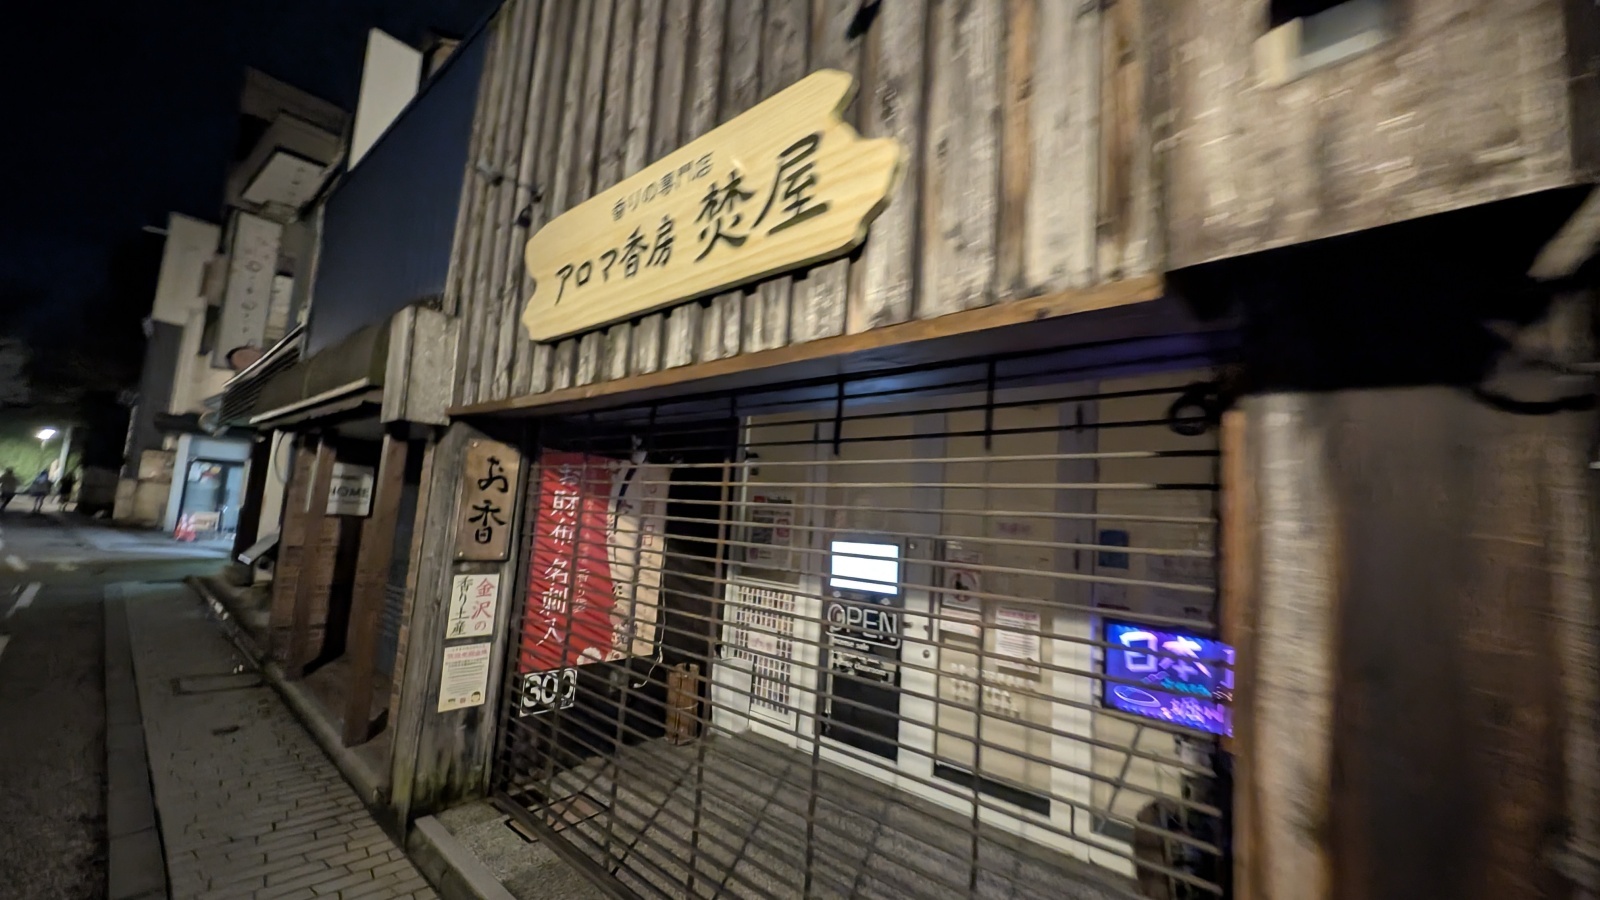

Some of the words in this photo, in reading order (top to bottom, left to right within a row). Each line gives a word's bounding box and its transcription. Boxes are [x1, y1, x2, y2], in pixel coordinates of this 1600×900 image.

[554, 213, 676, 305] アロマ香房
[694, 131, 831, 263] 焚屋
[611, 151, 714, 221] 香りの専門店
[468, 455, 509, 544] お香
[450, 575, 474, 636] 香り土産
[471, 577, 496, 631] 金沢の
[827, 603, 897, 642] OPEN
